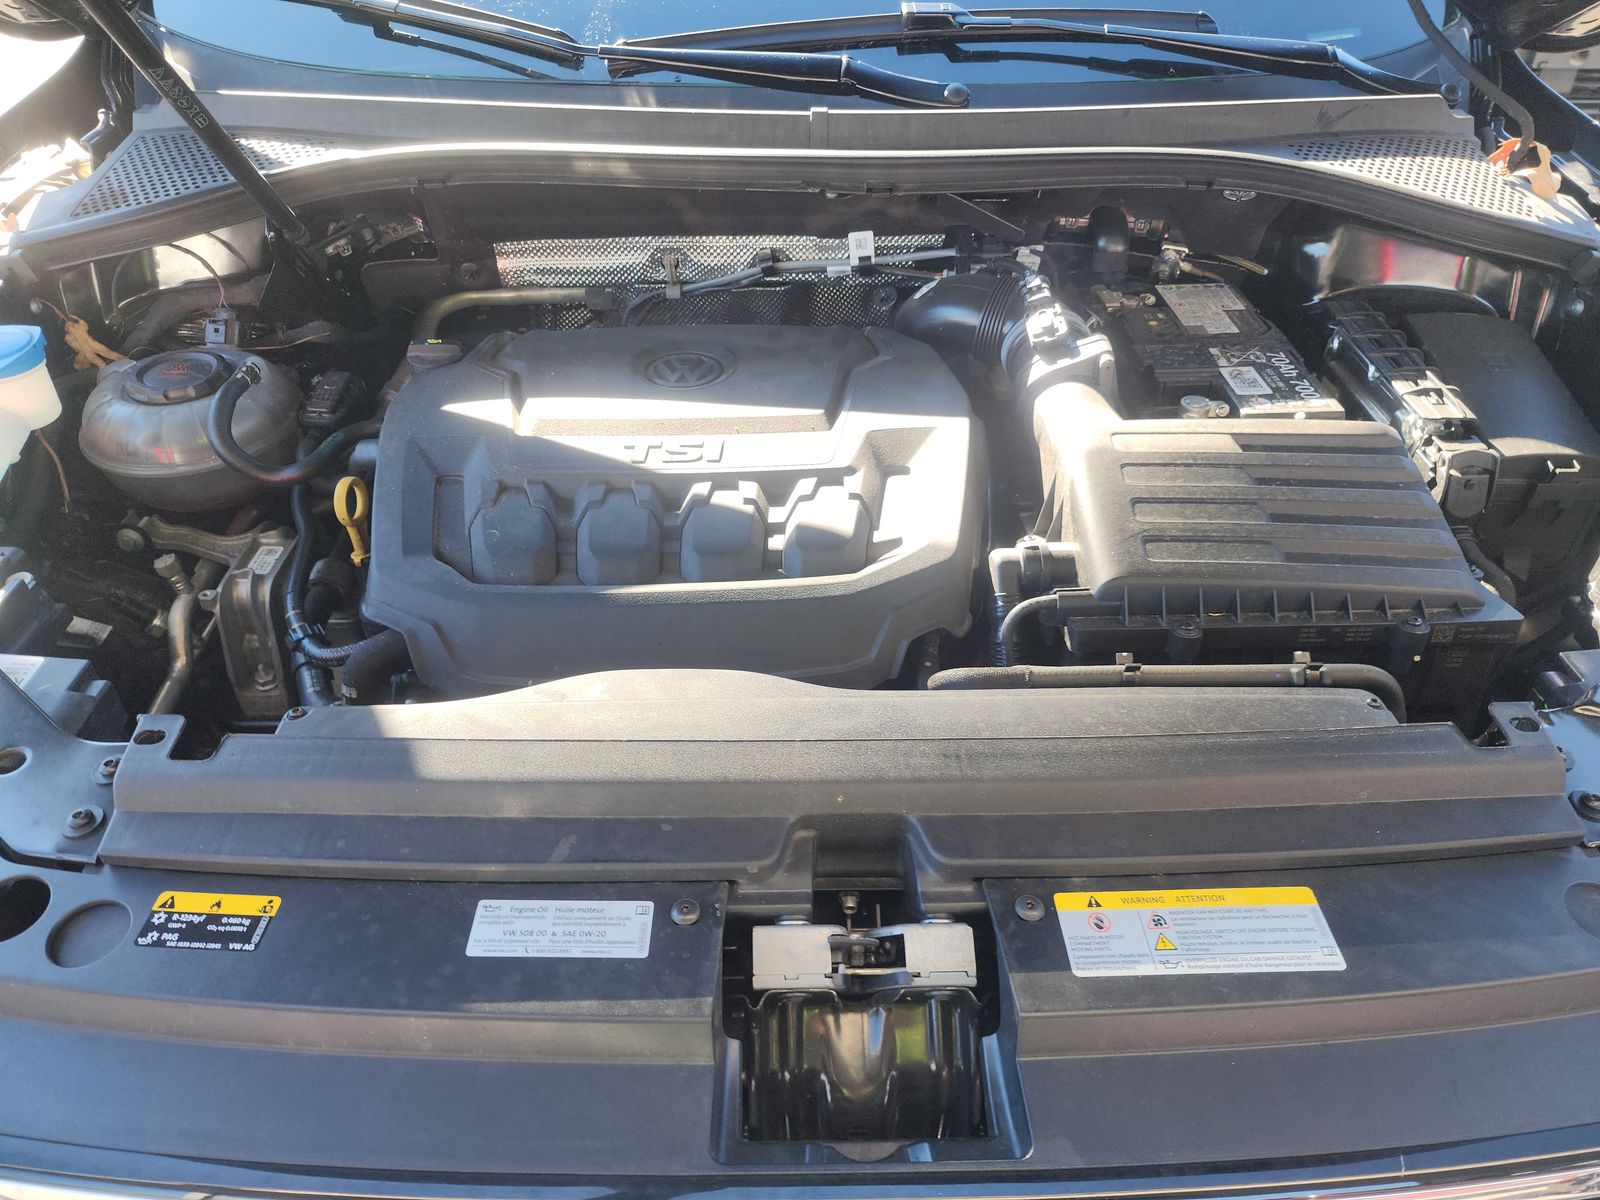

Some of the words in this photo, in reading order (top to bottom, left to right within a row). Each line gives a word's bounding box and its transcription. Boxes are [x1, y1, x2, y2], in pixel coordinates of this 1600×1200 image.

[1266, 351, 1301, 377] 70Ah
[1289, 379, 1321, 399] 700
[622, 440, 725, 464] TSI
[1120, 896, 1166, 904] WARNING
[1175, 894, 1226, 903] ATTENTION
[509, 906, 536, 914] Engine
[161, 932, 180, 941] PAG
[229, 942, 242, 950] VW
[242, 943, 256, 951] AG
